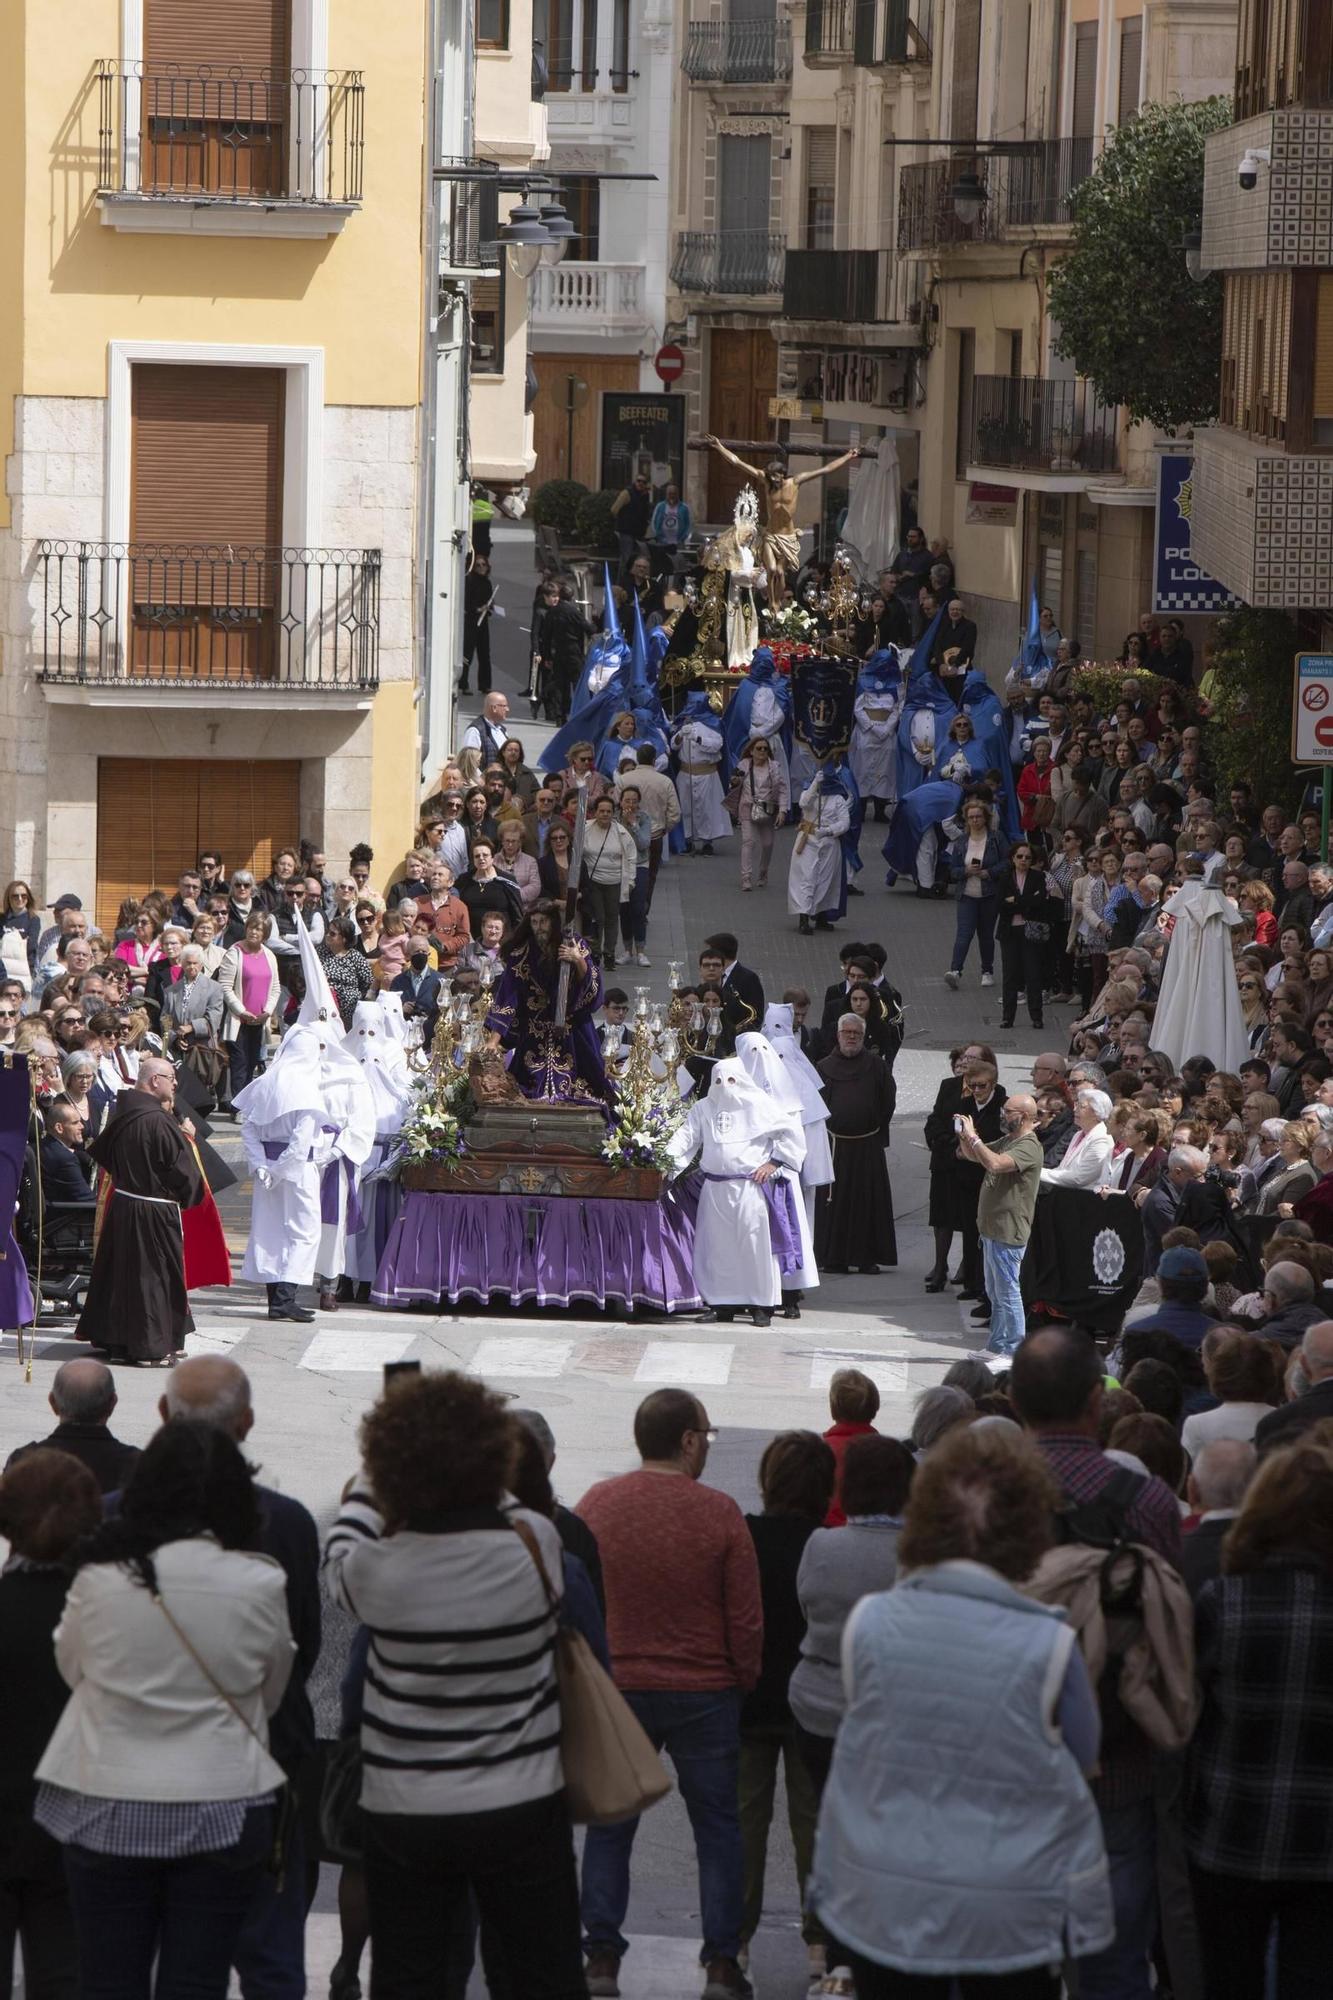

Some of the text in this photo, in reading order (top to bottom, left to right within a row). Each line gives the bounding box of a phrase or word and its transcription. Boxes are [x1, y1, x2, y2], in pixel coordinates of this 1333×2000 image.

[620, 406, 668, 422] BEEFEATER
[1165, 547, 1191, 560] PO
[1171, 568, 1213, 581] LOC
[1313, 786, 1324, 803] P
